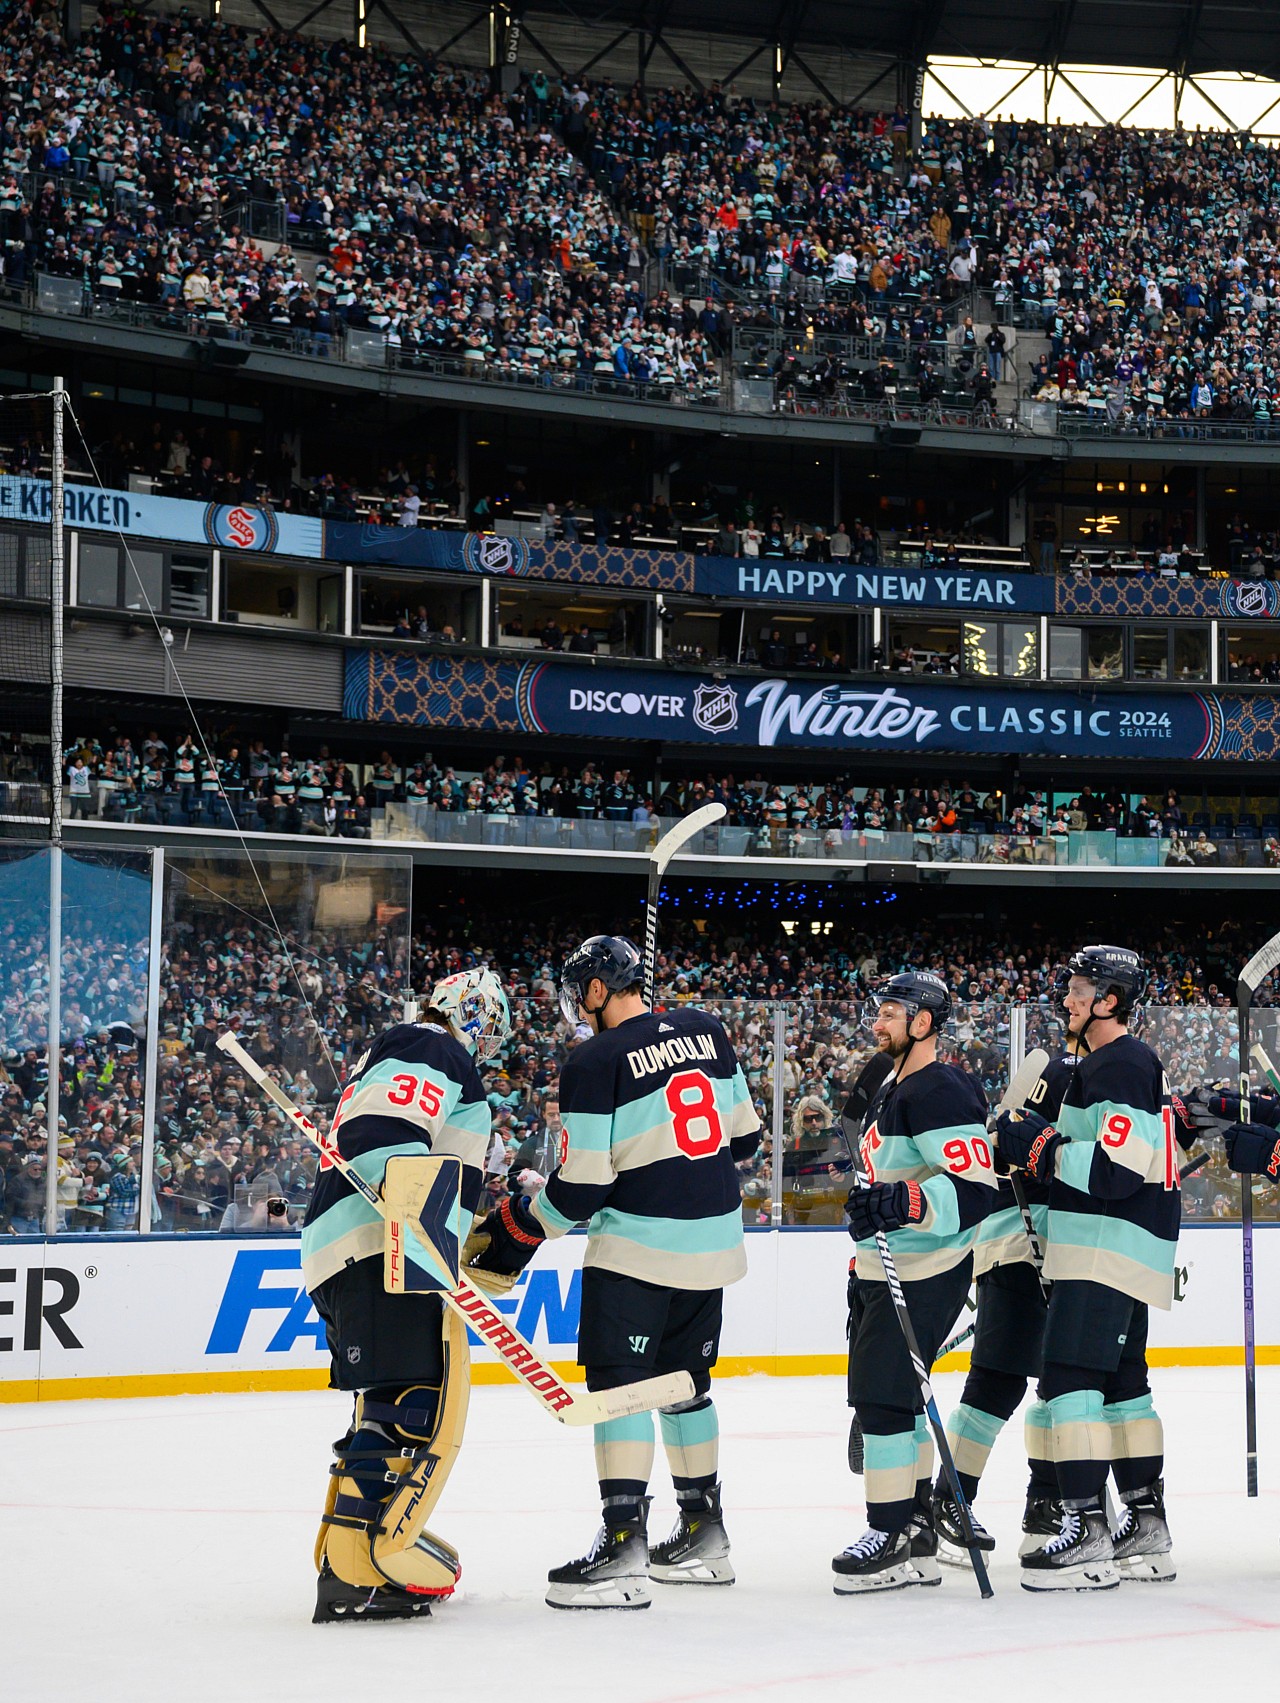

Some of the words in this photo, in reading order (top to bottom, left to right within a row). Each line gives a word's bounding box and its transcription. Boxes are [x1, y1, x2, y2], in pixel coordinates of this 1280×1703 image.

[506, 27, 520, 63] 329
[913, 74, 924, 109] 330
[738, 567, 846, 597] HAPPY
[856, 574, 926, 601] NEW
[935, 576, 1016, 605] YEAR
[569, 688, 685, 718] DISCOVER
[744, 679, 942, 746] Winter
[950, 705, 1111, 736] CLASSIC
[1119, 711, 1172, 728] 2024
[1119, 727, 1172, 738] SEATTLE
[1106, 952, 1138, 967] KRAKEN
[627, 1034, 718, 1079] DUMOULIN
[387, 1072, 446, 1117] 35
[664, 1068, 723, 1161] 8
[943, 1137, 992, 1174] 90
[1027, 1126, 1057, 1173] CCM
[391, 1220, 399, 1289] TRUE
[1243, 1237, 1253, 1312] RIBCOR
[447, 1280, 575, 1413] WARRIOR
[392, 1458, 438, 1540] TRUE
[580, 1556, 610, 1575] BAUER
